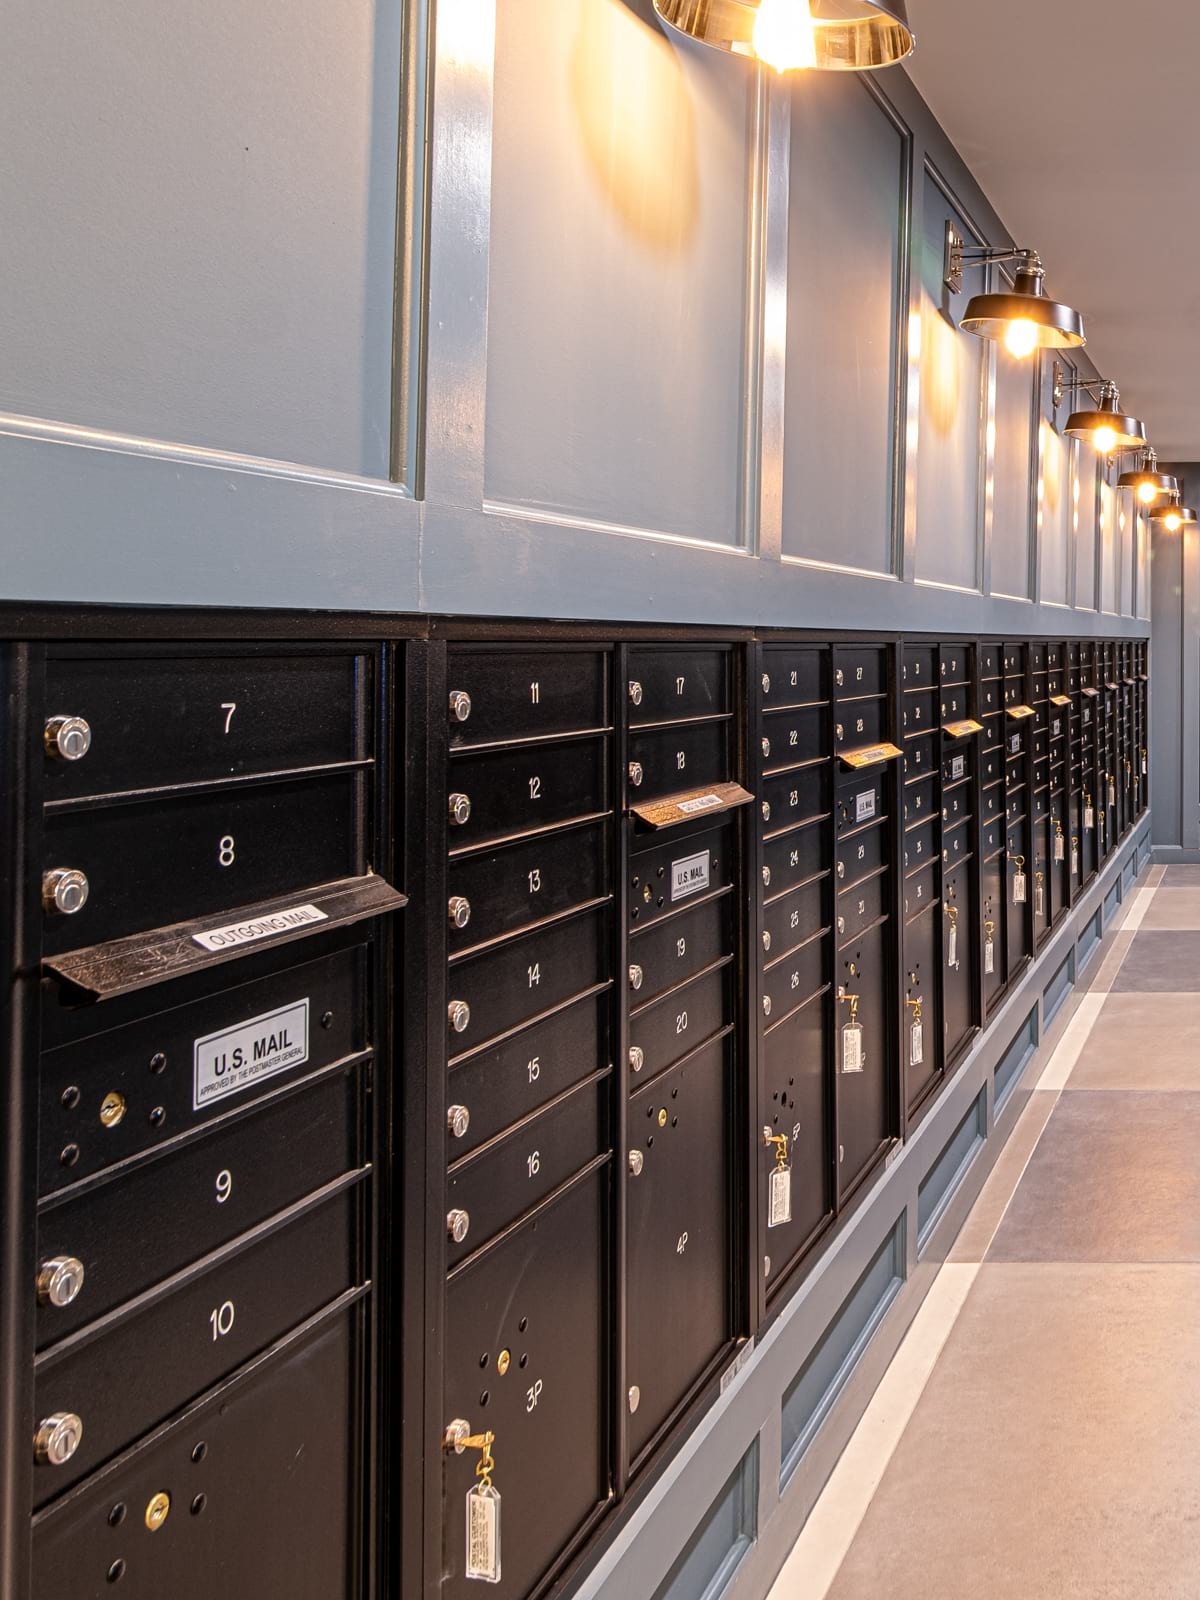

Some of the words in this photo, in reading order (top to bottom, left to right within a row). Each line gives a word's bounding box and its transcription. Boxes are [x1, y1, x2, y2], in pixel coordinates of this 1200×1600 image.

[676, 676, 685, 695] 17
[790, 671, 797, 686] 21
[530, 682, 539, 704] 11
[220, 702, 236, 734] 7
[789, 730, 798, 746] 22
[676, 751, 686, 770] 18
[528, 776, 541, 799] 12
[789, 790, 799, 807] 23
[219, 835, 235, 867] 8
[790, 849, 799, 867] 24
[528, 869, 541, 893] 13
[677, 871, 690, 886] U.S.
[690, 865, 704, 880] MAIL
[209, 918, 287, 946] OUTGOING
[287, 910, 319, 928] MAIL
[790, 910, 799, 928] 25
[676, 937, 686, 957] 19
[527, 963, 541, 988] 14
[791, 971, 800, 989] 26
[676, 1011, 688, 1034] 20
[214, 1047, 248, 1076] U.S.
[253, 1029, 293, 1061] MAIL
[199, 1077, 230, 1097] APPROVED
[230, 1073, 237, 1085] BY
[238, 1069, 248, 1080] THE
[248, 1057, 281, 1077] POSTMASTER
[281, 1046, 303, 1064] GENERAL
[527, 1056, 540, 1083] 15
[527, 1150, 540, 1178] 16
[215, 1169, 232, 1203] 9
[676, 1231, 688, 1255] 4P
[209, 1300, 235, 1341] 10
[526, 1379, 543, 1413] 3P
